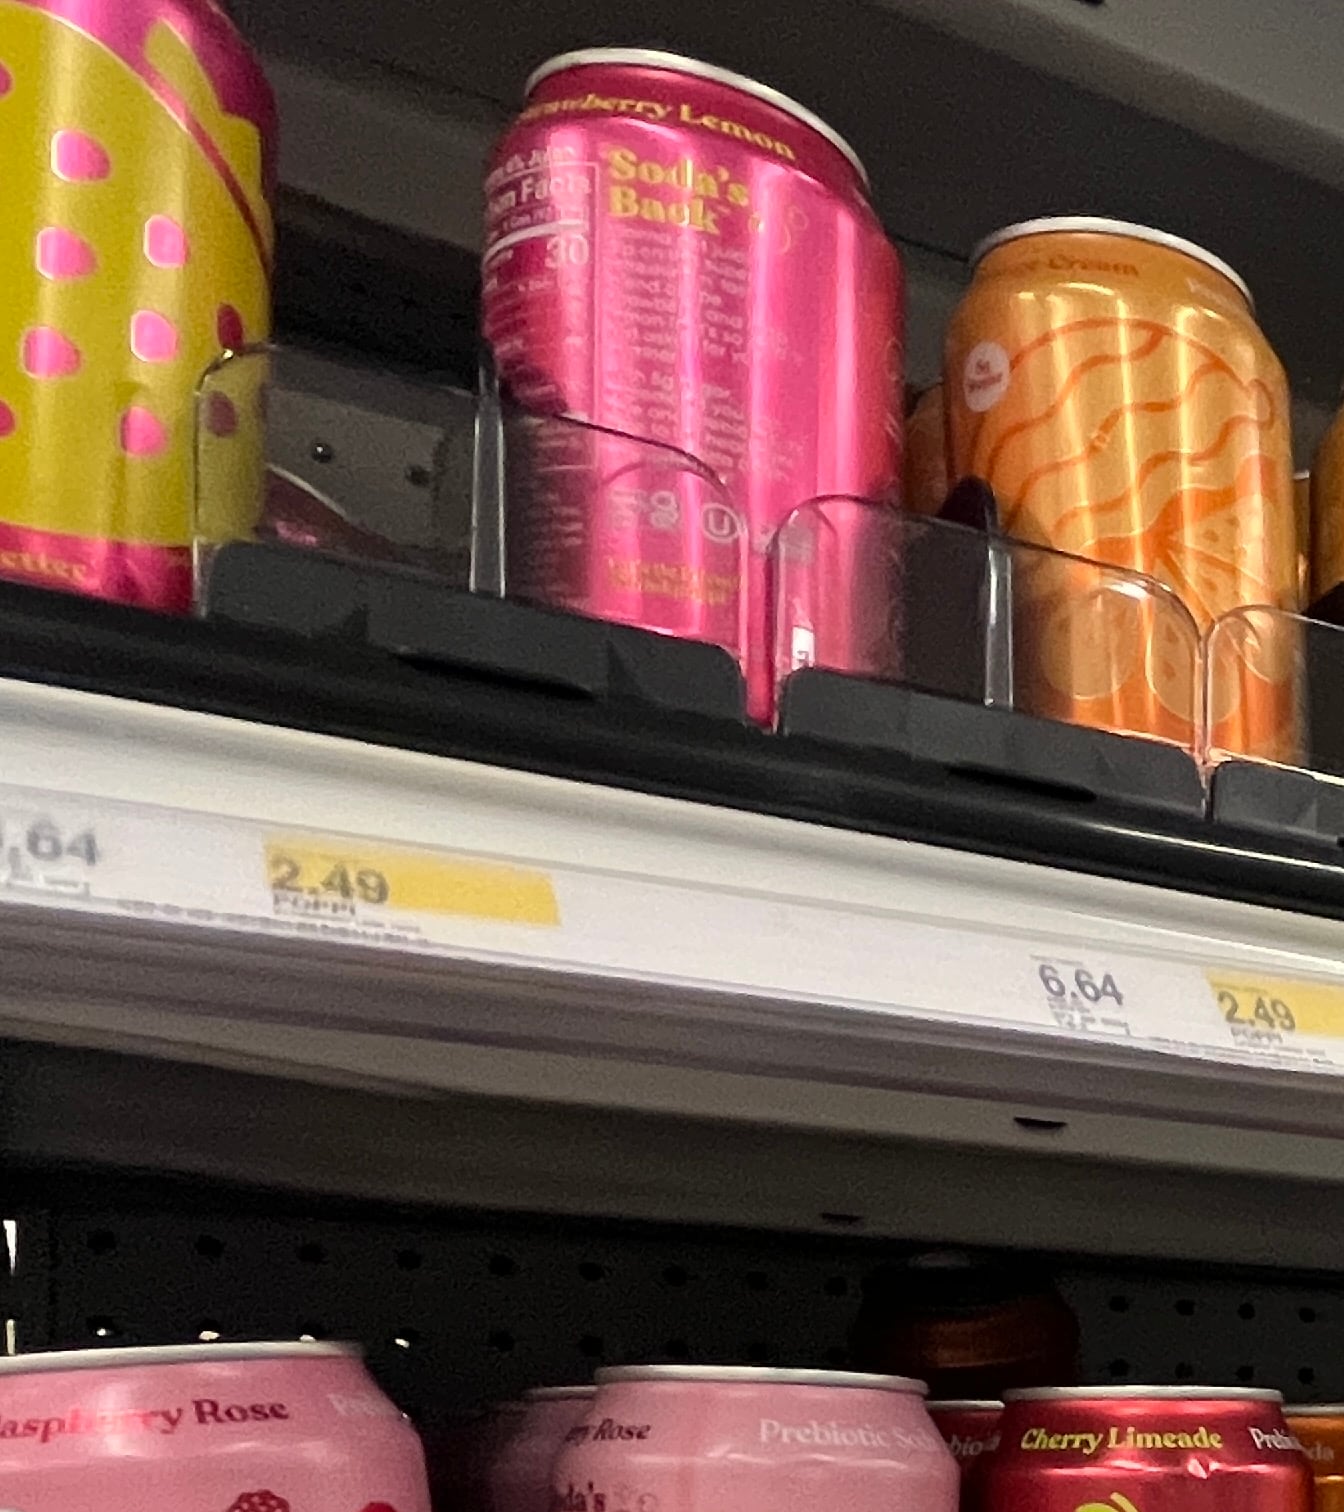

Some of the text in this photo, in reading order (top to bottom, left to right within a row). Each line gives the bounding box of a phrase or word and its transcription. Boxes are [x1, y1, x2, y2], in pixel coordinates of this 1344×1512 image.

[679, 103, 796, 161] Lemon
[608, 146, 750, 207] Soda's
[608, 186, 720, 235] Back
[545, 233, 590, 268] 30
[0, 815, 99, 869] .64
[270, 855, 391, 906] 2.49
[1038, 964, 1124, 1007] 6.64
[1217, 990, 1297, 1033] 2.49
[0, 1398, 290, 1443] aspberry Rose
[593, 1417, 652, 1442] Rose
[758, 1417, 888, 1450] Prebiotic
[1019, 1426, 1223, 1458] Cherry Limeade
